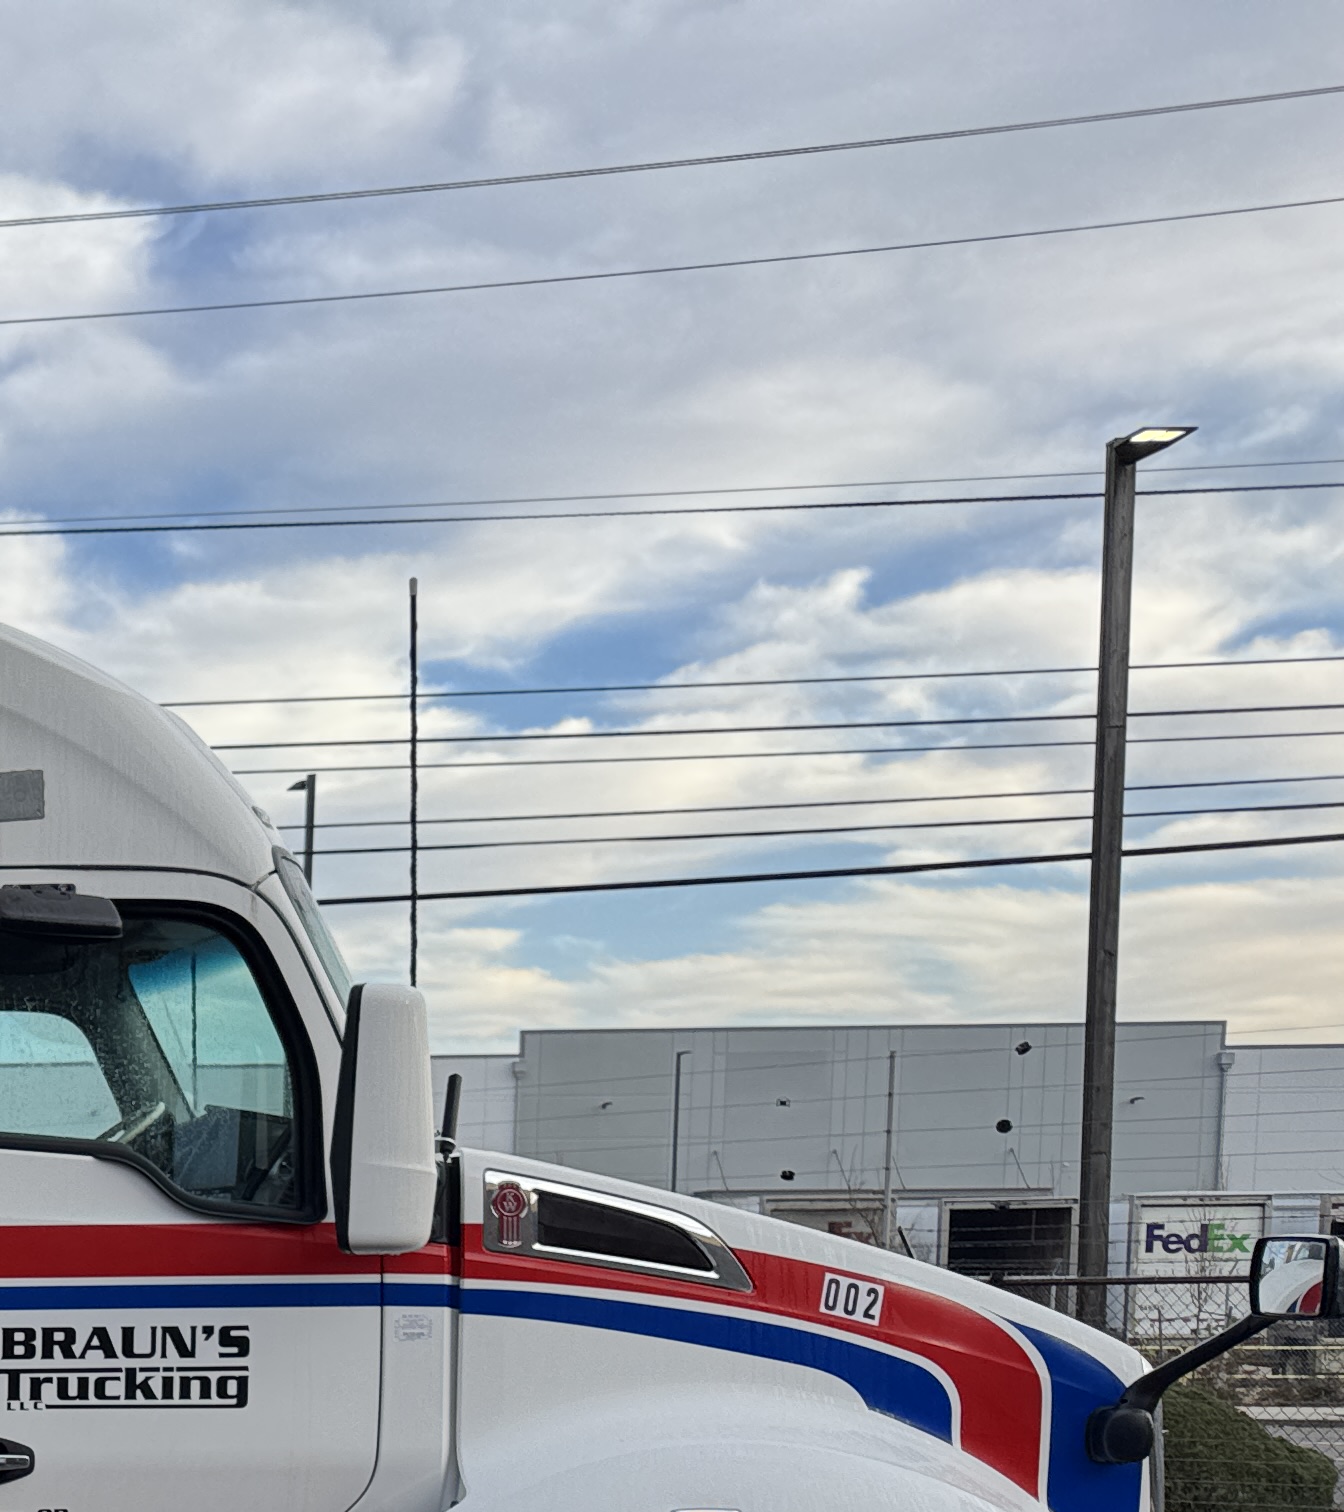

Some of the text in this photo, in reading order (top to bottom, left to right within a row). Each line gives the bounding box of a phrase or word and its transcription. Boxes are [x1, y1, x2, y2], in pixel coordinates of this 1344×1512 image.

[1145, 1223, 1251, 1253] FedEx
[823, 1278, 880, 1322] 002
[1, 1325, 250, 1360] BRAUN'S
